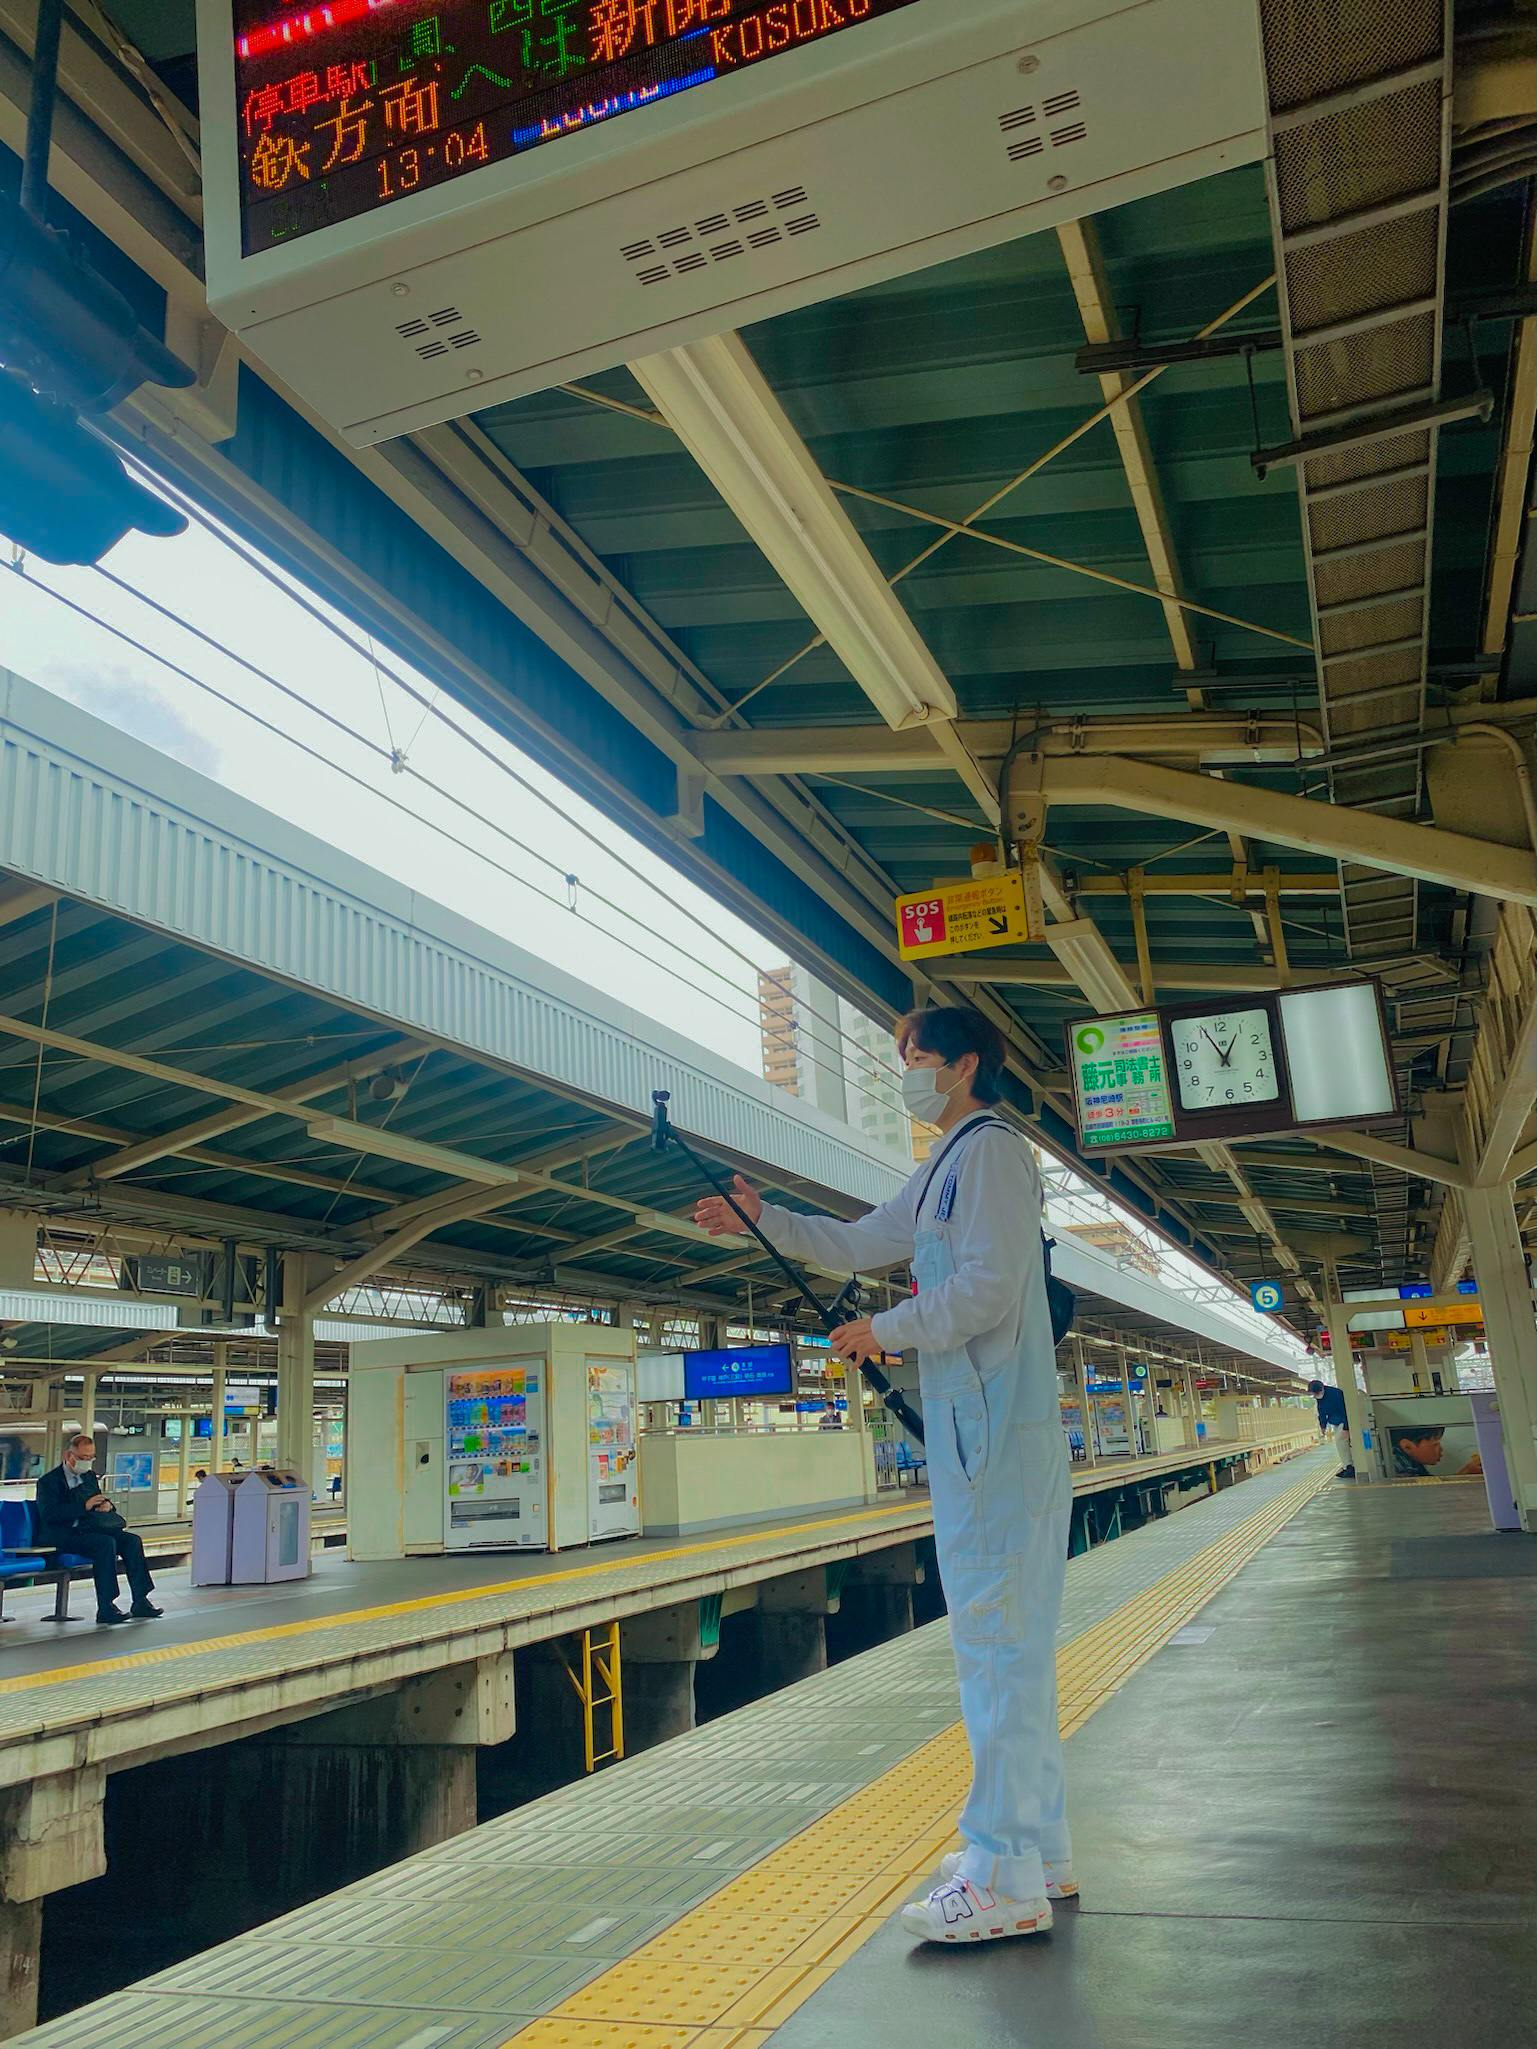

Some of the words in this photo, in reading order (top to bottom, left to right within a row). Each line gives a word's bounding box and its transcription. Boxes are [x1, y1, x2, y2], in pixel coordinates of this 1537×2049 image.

[946, 900, 981, 912] Emergency
[982, 897, 1004, 906] Button
[904, 901, 939, 920] SOS
[1214, 1022, 1227, 1032] 12
[1250, 1034, 1260, 1045] 2
[1186, 1042, 1199, 1053] 10
[1258, 1050, 1267, 1061] 3
[1183, 1059, 1192, 1070] 9
[1255, 1068, 1264, 1078] 4
[1191, 1075, 1200, 1086] 8
[1205, 1086, 1215, 1097] 7
[1243, 1082, 1252, 1093] 5
[1225, 1088, 1234, 1099] 6
[943, 1174, 955, 1205] TOMMY
[1262, 1290, 1274, 1305] 5
